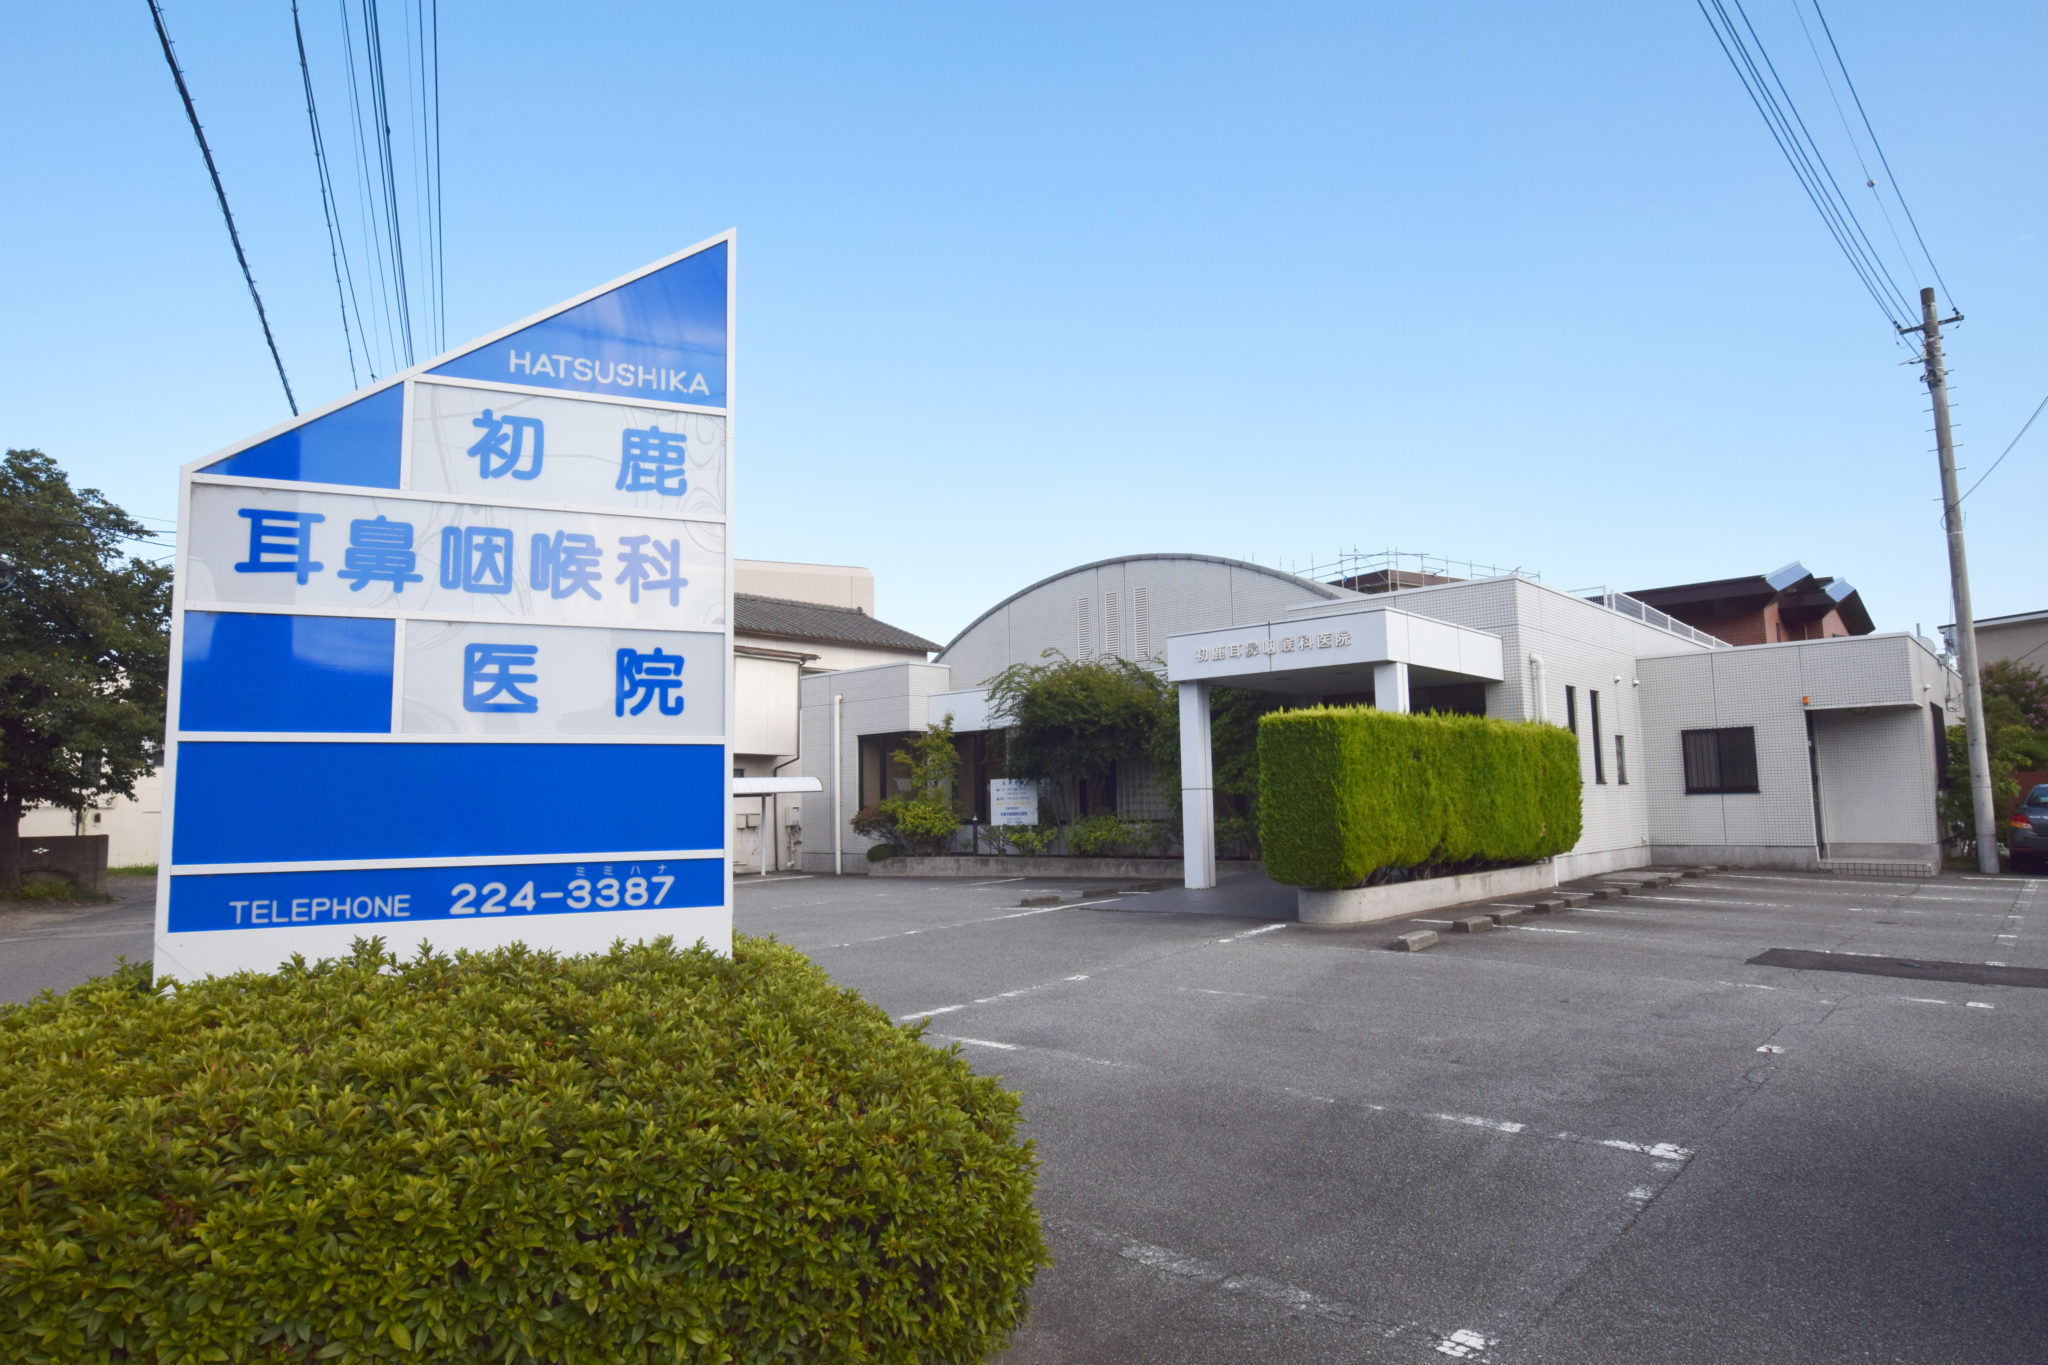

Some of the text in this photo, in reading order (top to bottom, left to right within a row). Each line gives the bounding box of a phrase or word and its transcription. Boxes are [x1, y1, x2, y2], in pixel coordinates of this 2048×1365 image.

[509, 349, 709, 395] HATSUSHIKA
[235, 508, 689, 605] 耳鼻咽喉科
[229, 895, 411, 924] TELEPHONE
[449, 875, 675, 915] 224-3387
